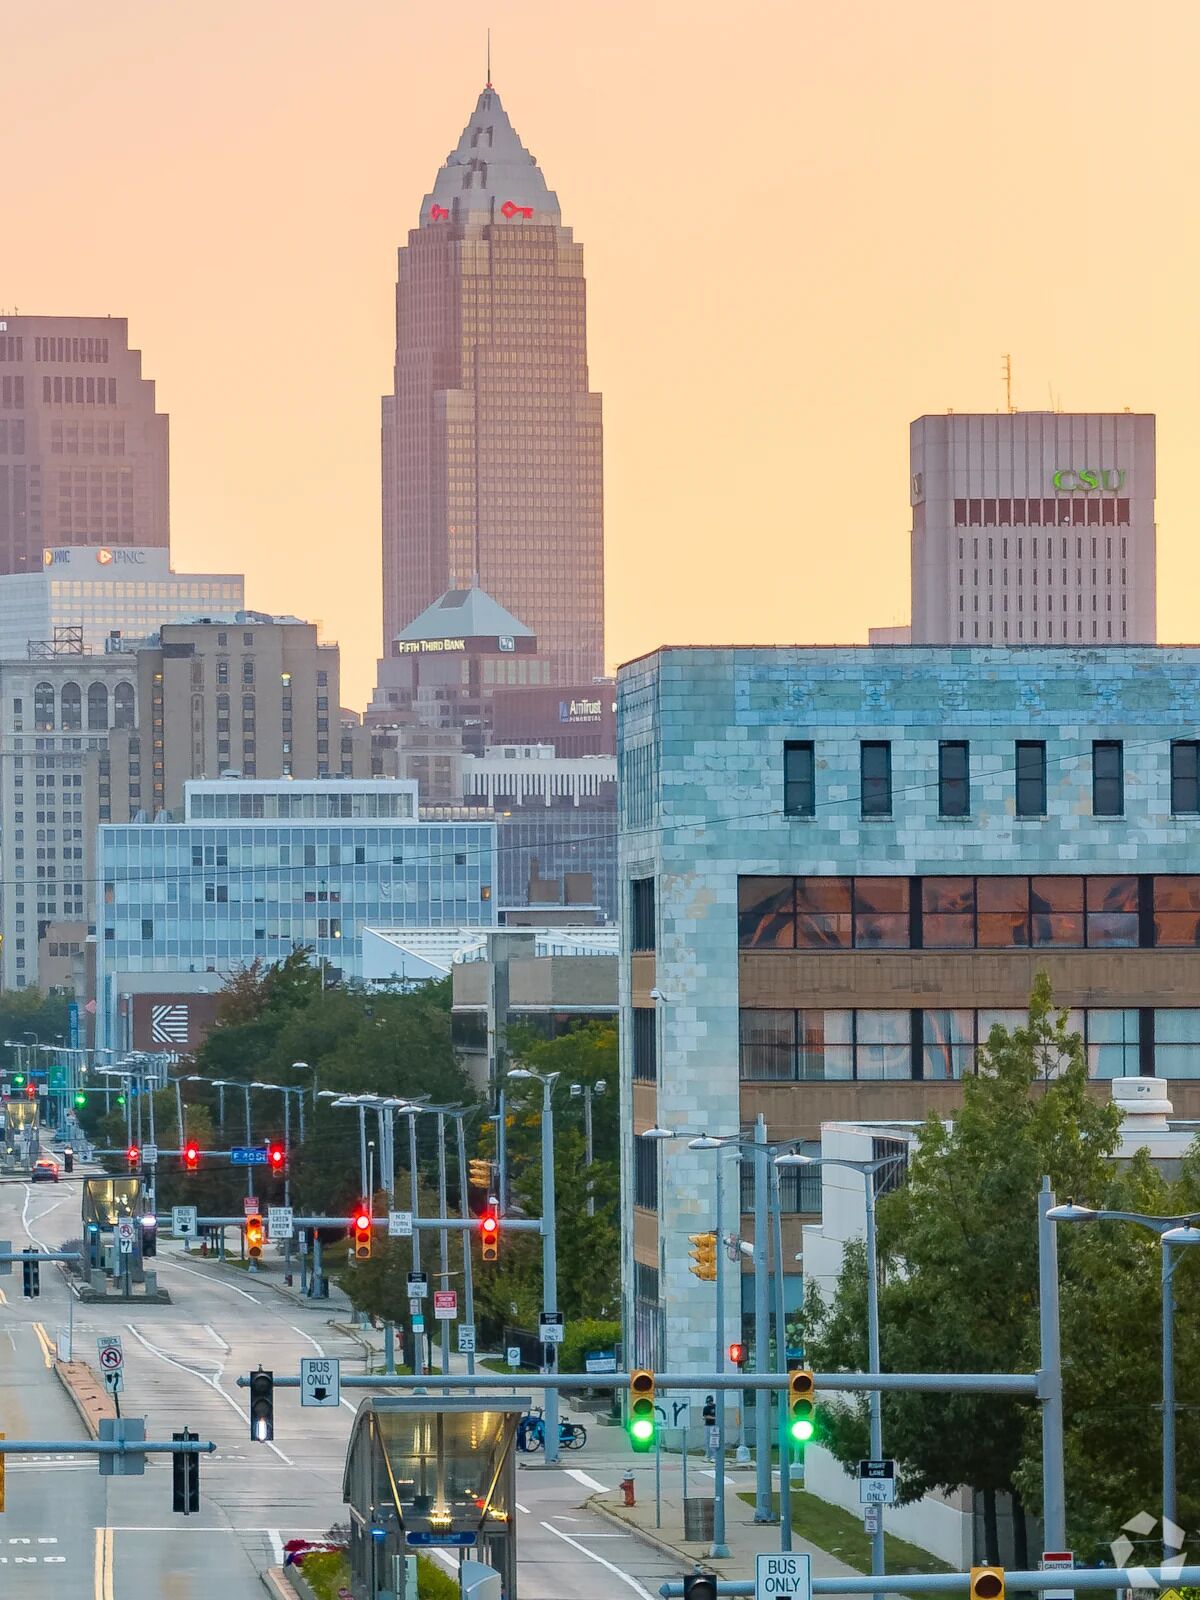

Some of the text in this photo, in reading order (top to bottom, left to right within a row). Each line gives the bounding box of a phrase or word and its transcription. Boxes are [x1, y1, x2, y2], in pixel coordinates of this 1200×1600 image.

[1053, 469, 1125, 491] CSU
[113, 551, 145, 564] PNC
[400, 639, 465, 653] FIFTH THIRD BANK
[570, 700, 602, 715] AmTrust
[460, 1339, 474, 1350] 25
[309, 1362, 330, 1373] BUS
[307, 1374, 332, 1385] ONLY
[866, 1493, 887, 1501] ONLY
[768, 1560, 796, 1574] BUS
[765, 1577, 801, 1592] ONLY
